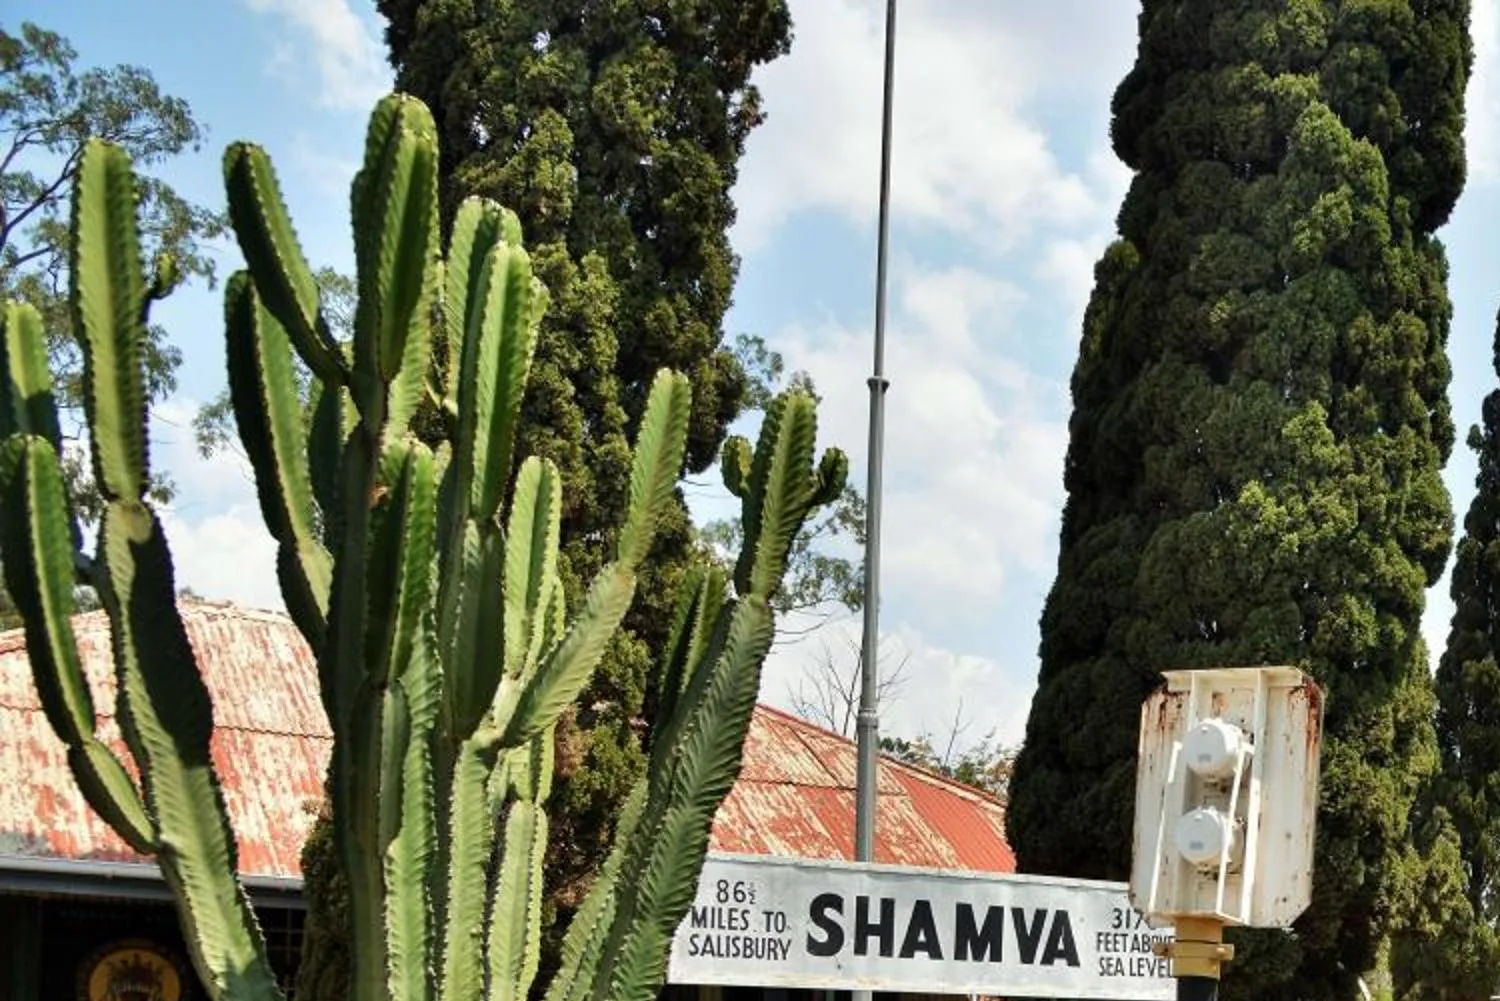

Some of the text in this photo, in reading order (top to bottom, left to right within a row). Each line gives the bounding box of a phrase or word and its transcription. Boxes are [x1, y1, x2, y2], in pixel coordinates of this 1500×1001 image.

[690, 906, 787, 933] MILES TO
[806, 892, 1081, 968] SHAMVA
[1112, 907, 1157, 931] 317
[688, 933, 792, 961] SALISBURY
[1096, 931, 1129, 953] FEET
[1099, 957, 1174, 978] SEA LEVEL
